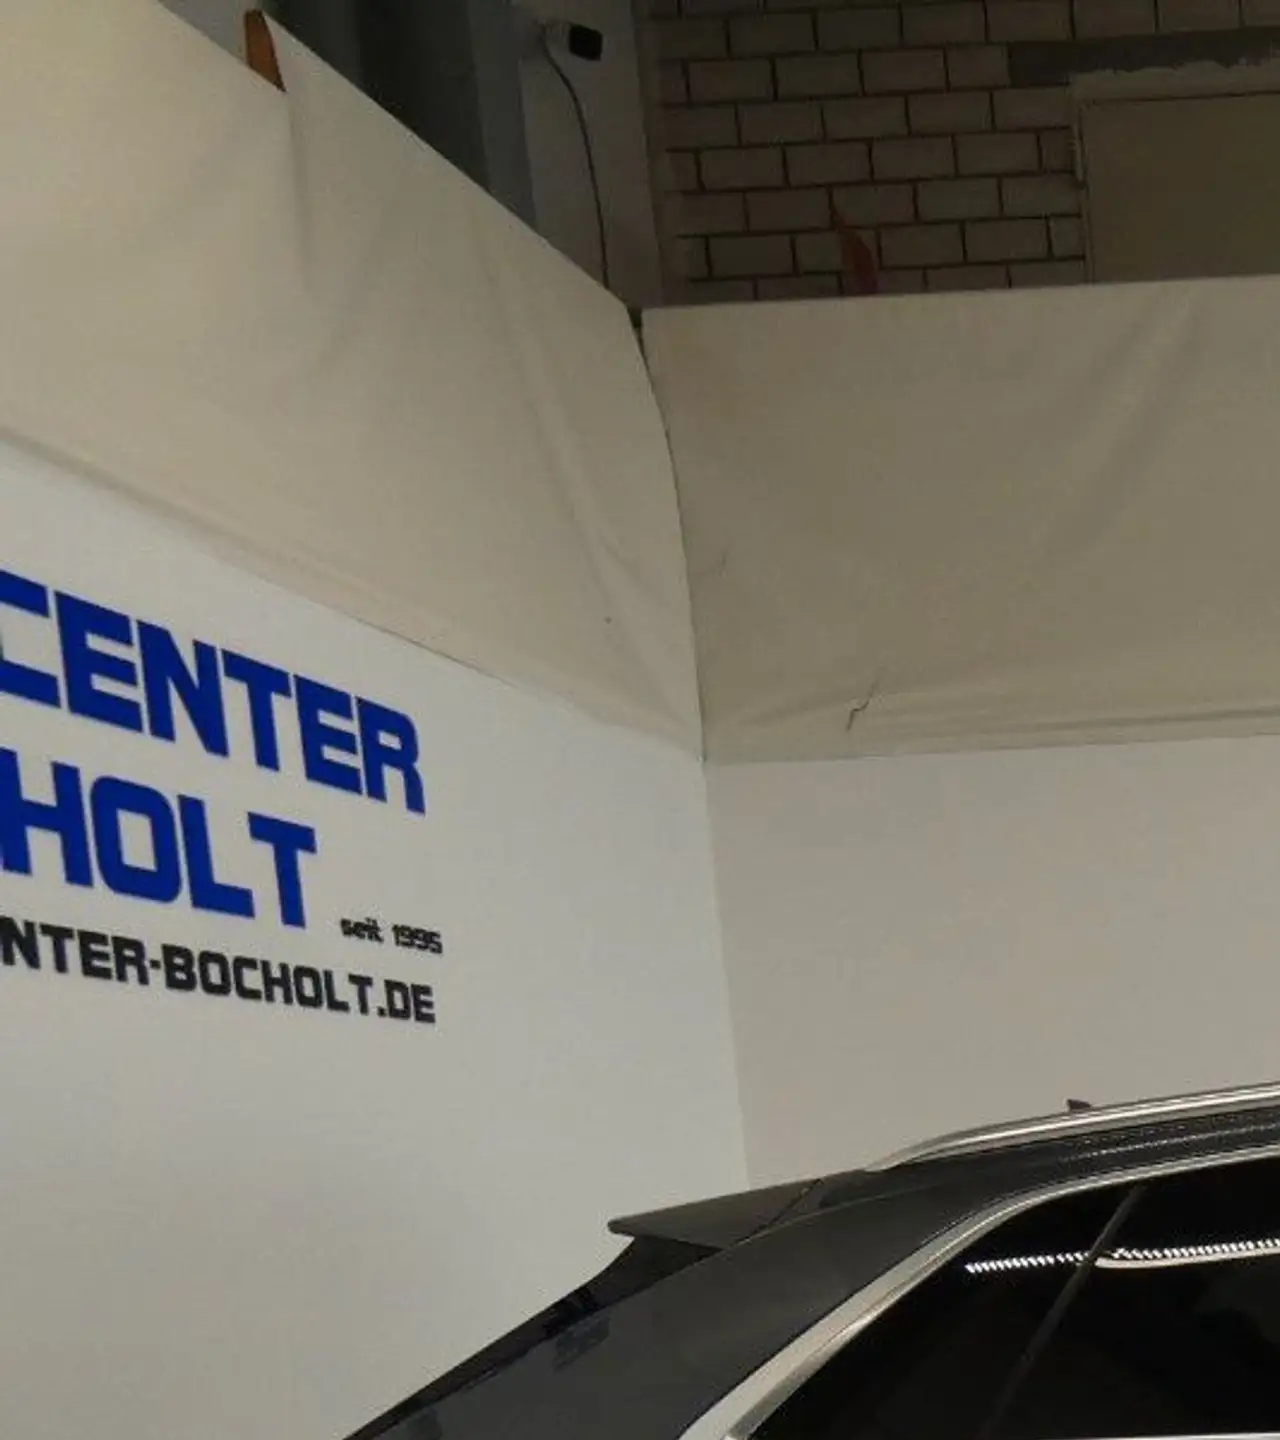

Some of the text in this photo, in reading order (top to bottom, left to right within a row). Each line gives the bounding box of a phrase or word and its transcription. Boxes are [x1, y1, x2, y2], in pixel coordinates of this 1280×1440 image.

[0, 569, 425, 814] CENTER
[0, 746, 317, 928] HOLT
[340, 916, 443, 955] seit 1995
